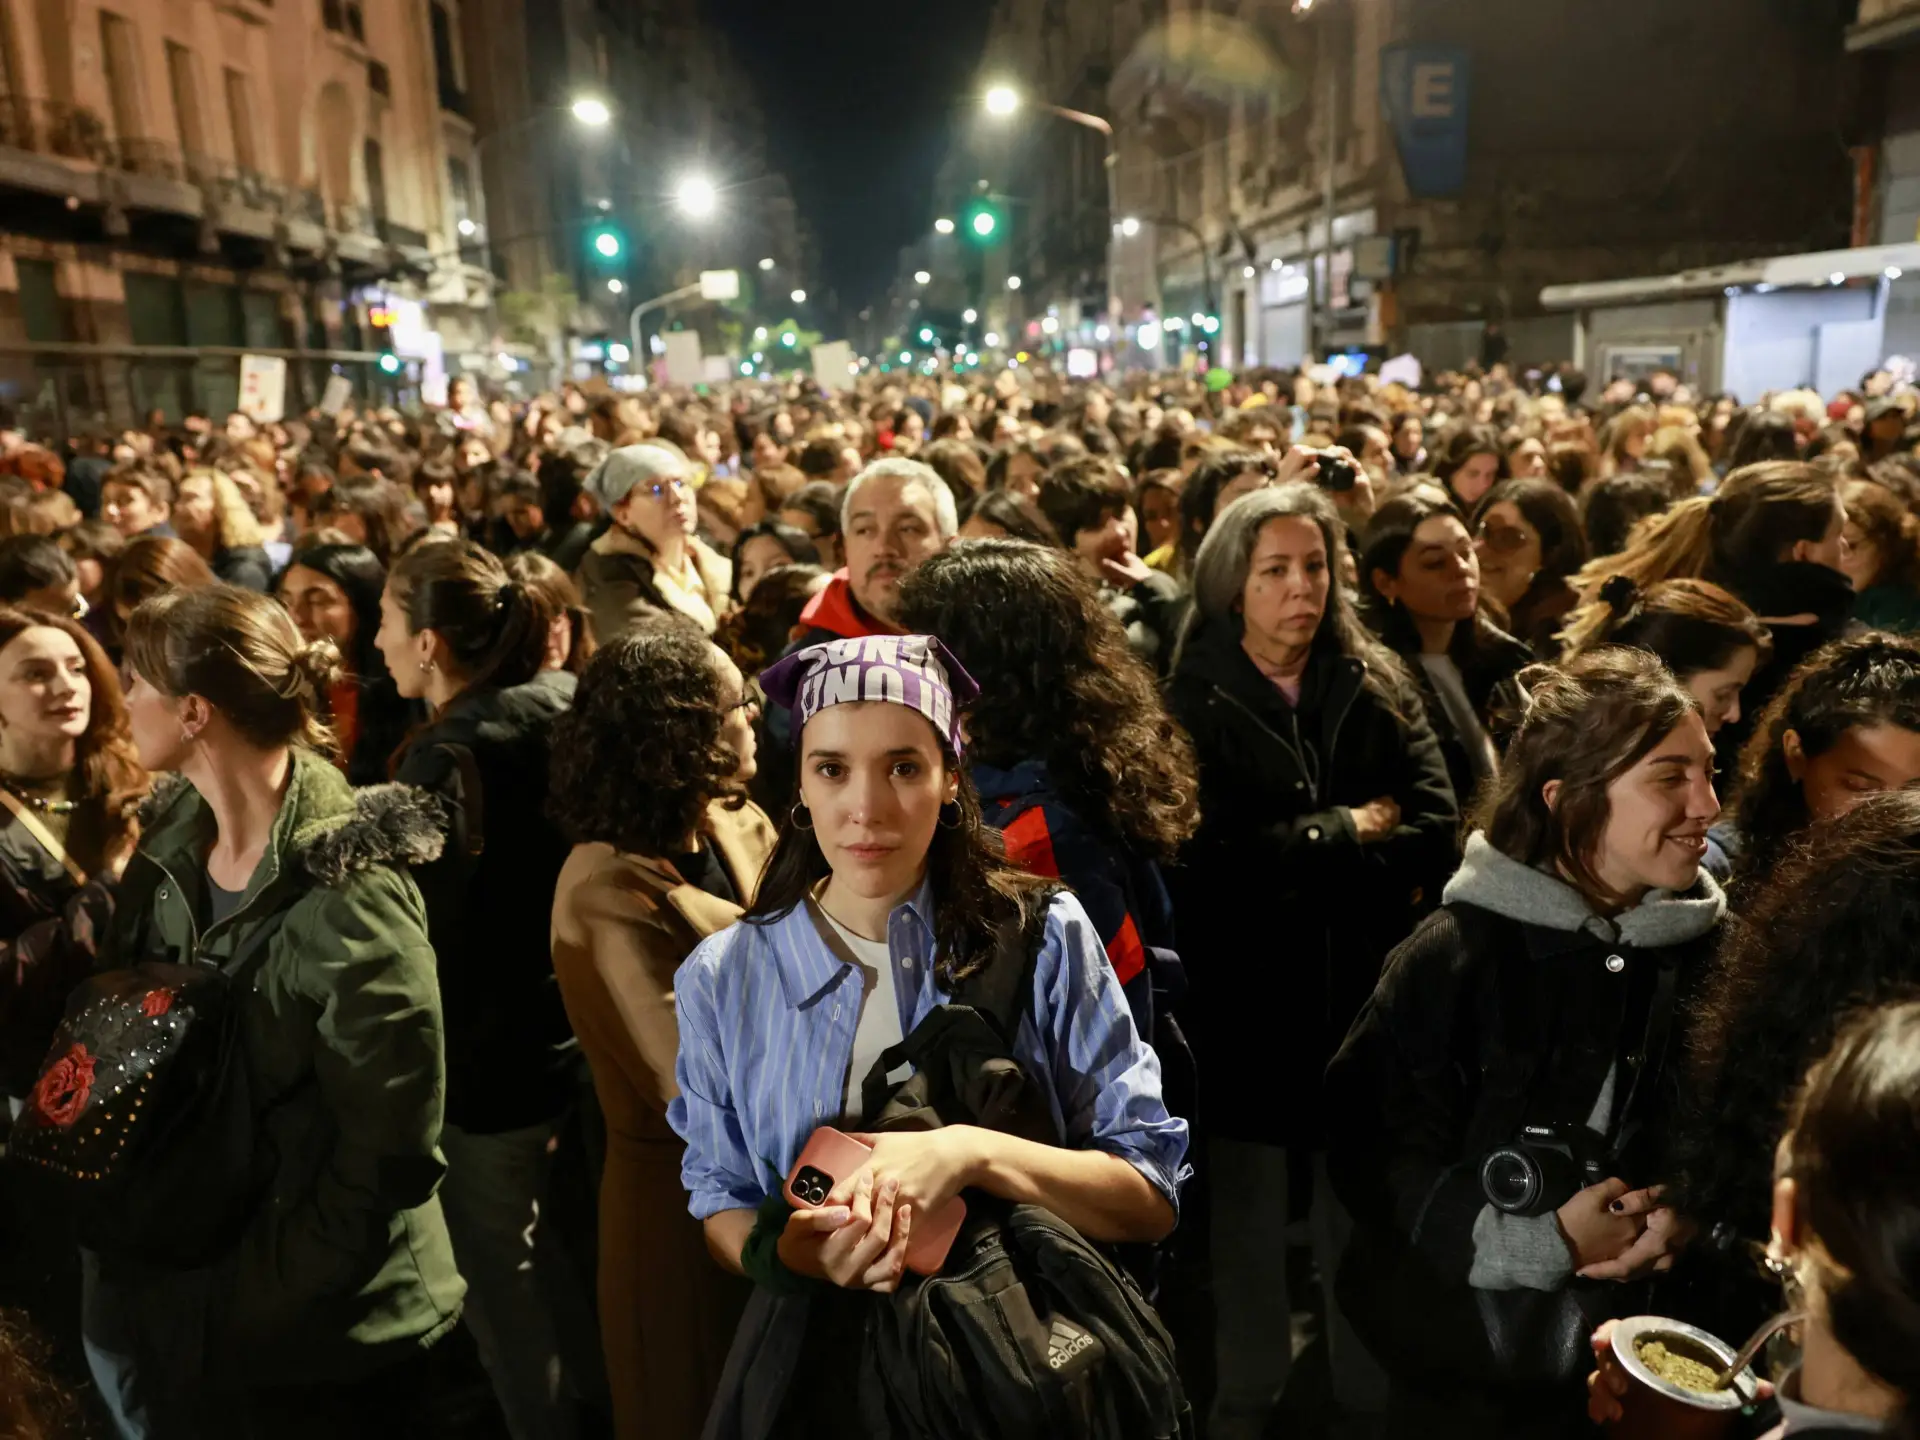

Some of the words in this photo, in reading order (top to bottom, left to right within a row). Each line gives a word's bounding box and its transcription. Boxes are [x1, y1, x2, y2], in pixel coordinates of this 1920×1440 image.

[1412, 63, 1454, 117] E
[1525, 1126, 1549, 1135] Canon
[1050, 1334, 1094, 1369] adidas
